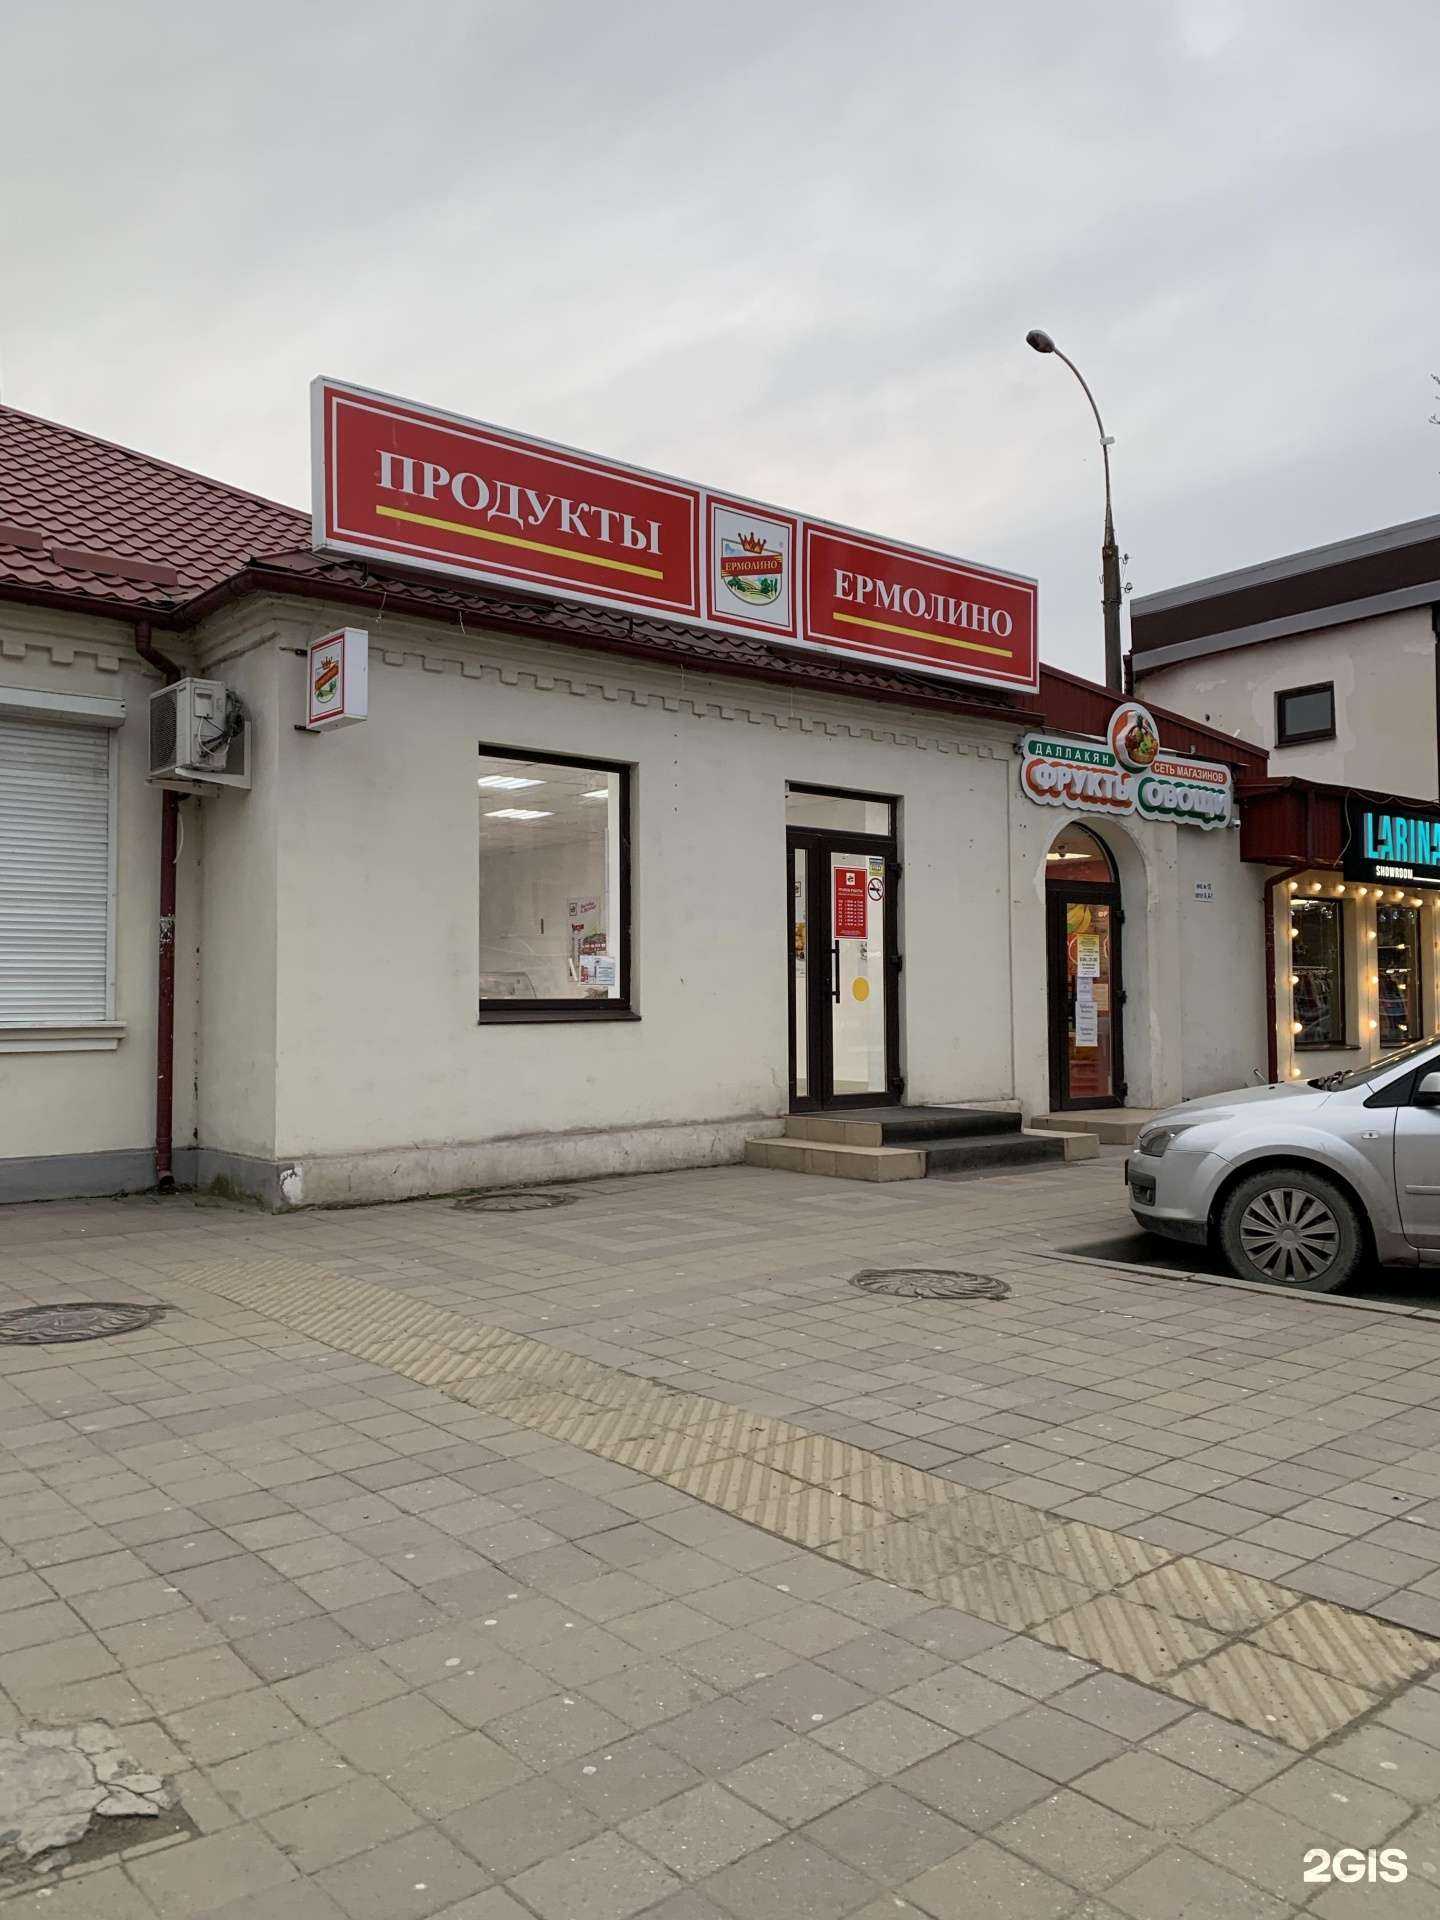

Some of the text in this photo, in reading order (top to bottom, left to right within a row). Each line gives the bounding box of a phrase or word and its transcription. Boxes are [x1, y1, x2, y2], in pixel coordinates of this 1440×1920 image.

[375, 449, 663, 555] ПРОДУКТЫ
[725, 558, 778, 572] ЕРМОЛИНО
[833, 568, 1013, 637] ЕРМОЛИНО
[1035, 742, 1110, 765] ДАЛЛАКЯН
[1033, 762, 1134, 801] ФРУКТЫ
[1154, 762, 1224, 783] СЕТЬ МАГАЗИНОВ
[1146, 781, 1226, 817] ОВОЩИ
[1375, 865, 1414, 880] SHOWROOM
